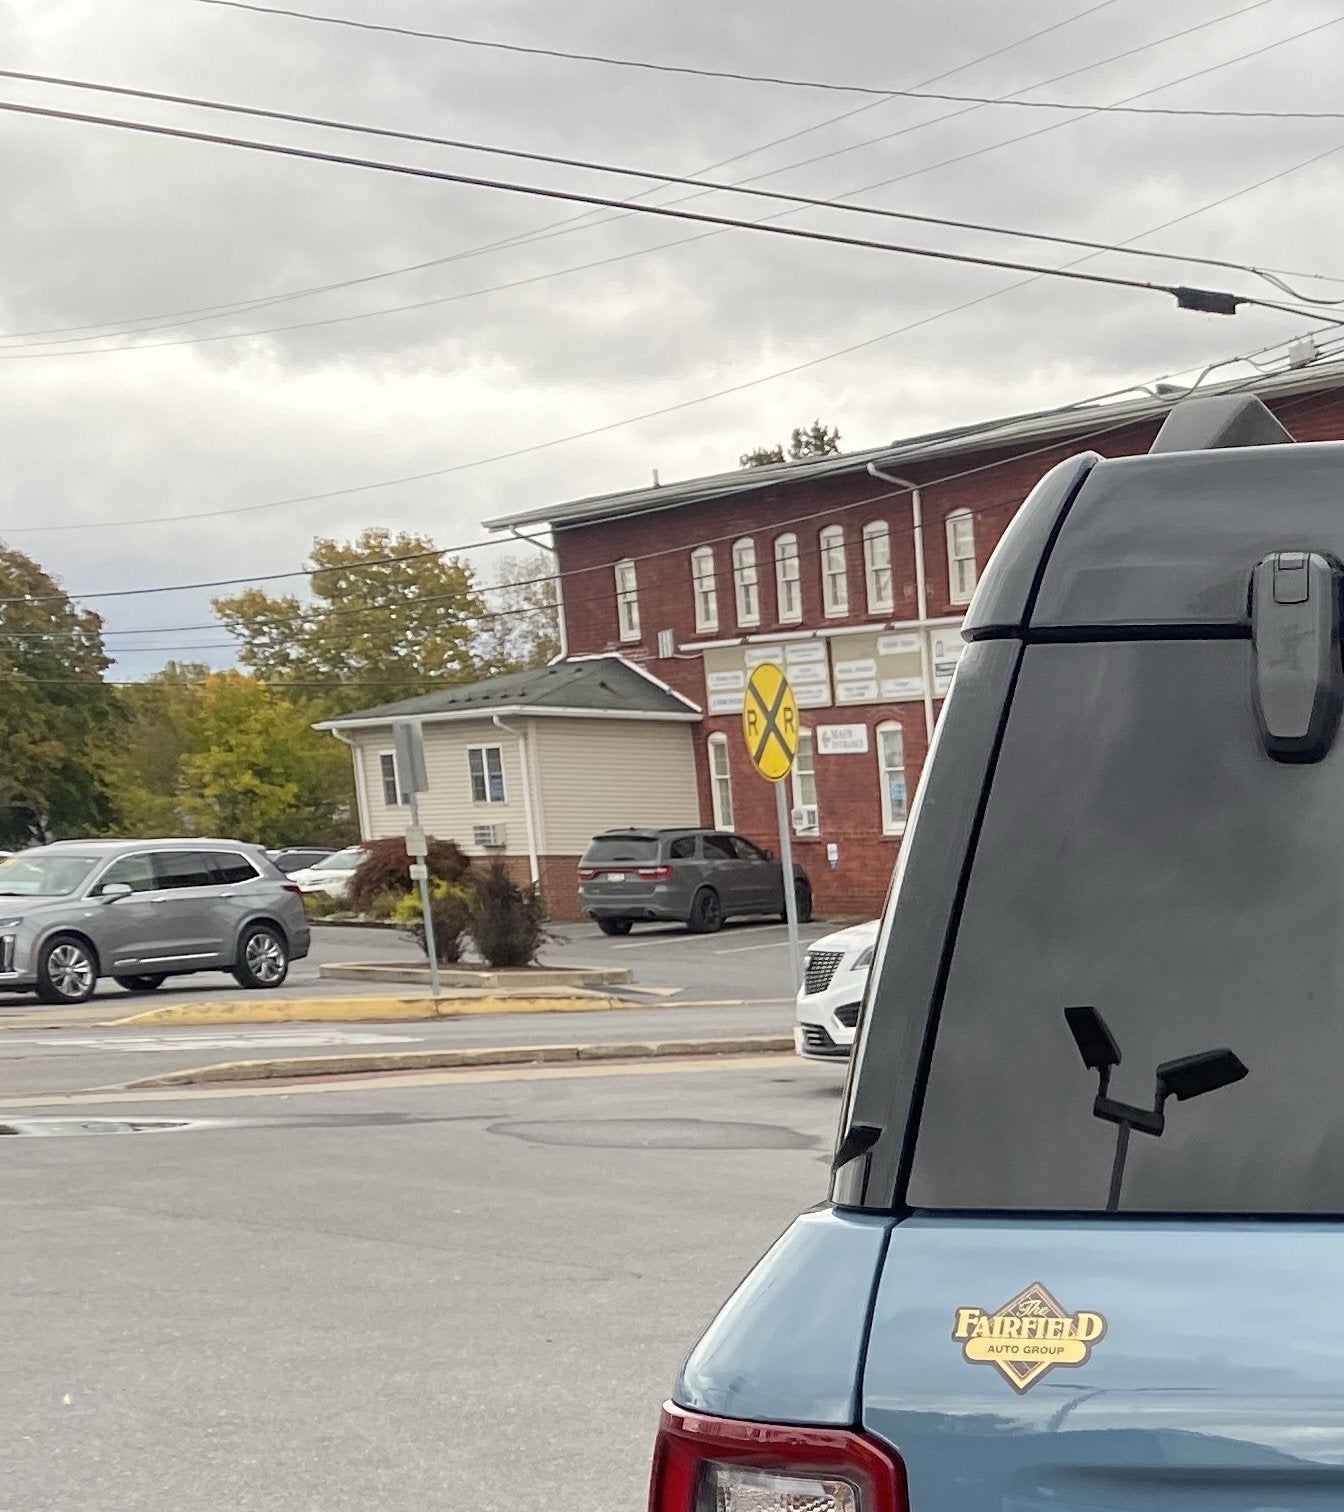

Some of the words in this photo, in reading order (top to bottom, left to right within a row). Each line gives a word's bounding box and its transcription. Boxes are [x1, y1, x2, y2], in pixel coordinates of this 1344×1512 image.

[747, 709, 758, 736] R
[783, 706, 795, 734] R
[1016, 1300, 1050, 1318] The
[955, 1309, 1103, 1341] FAIRFIELD
[987, 1345, 1020, 1354] AUTO
[1023, 1345, 1065, 1355] GROUP
